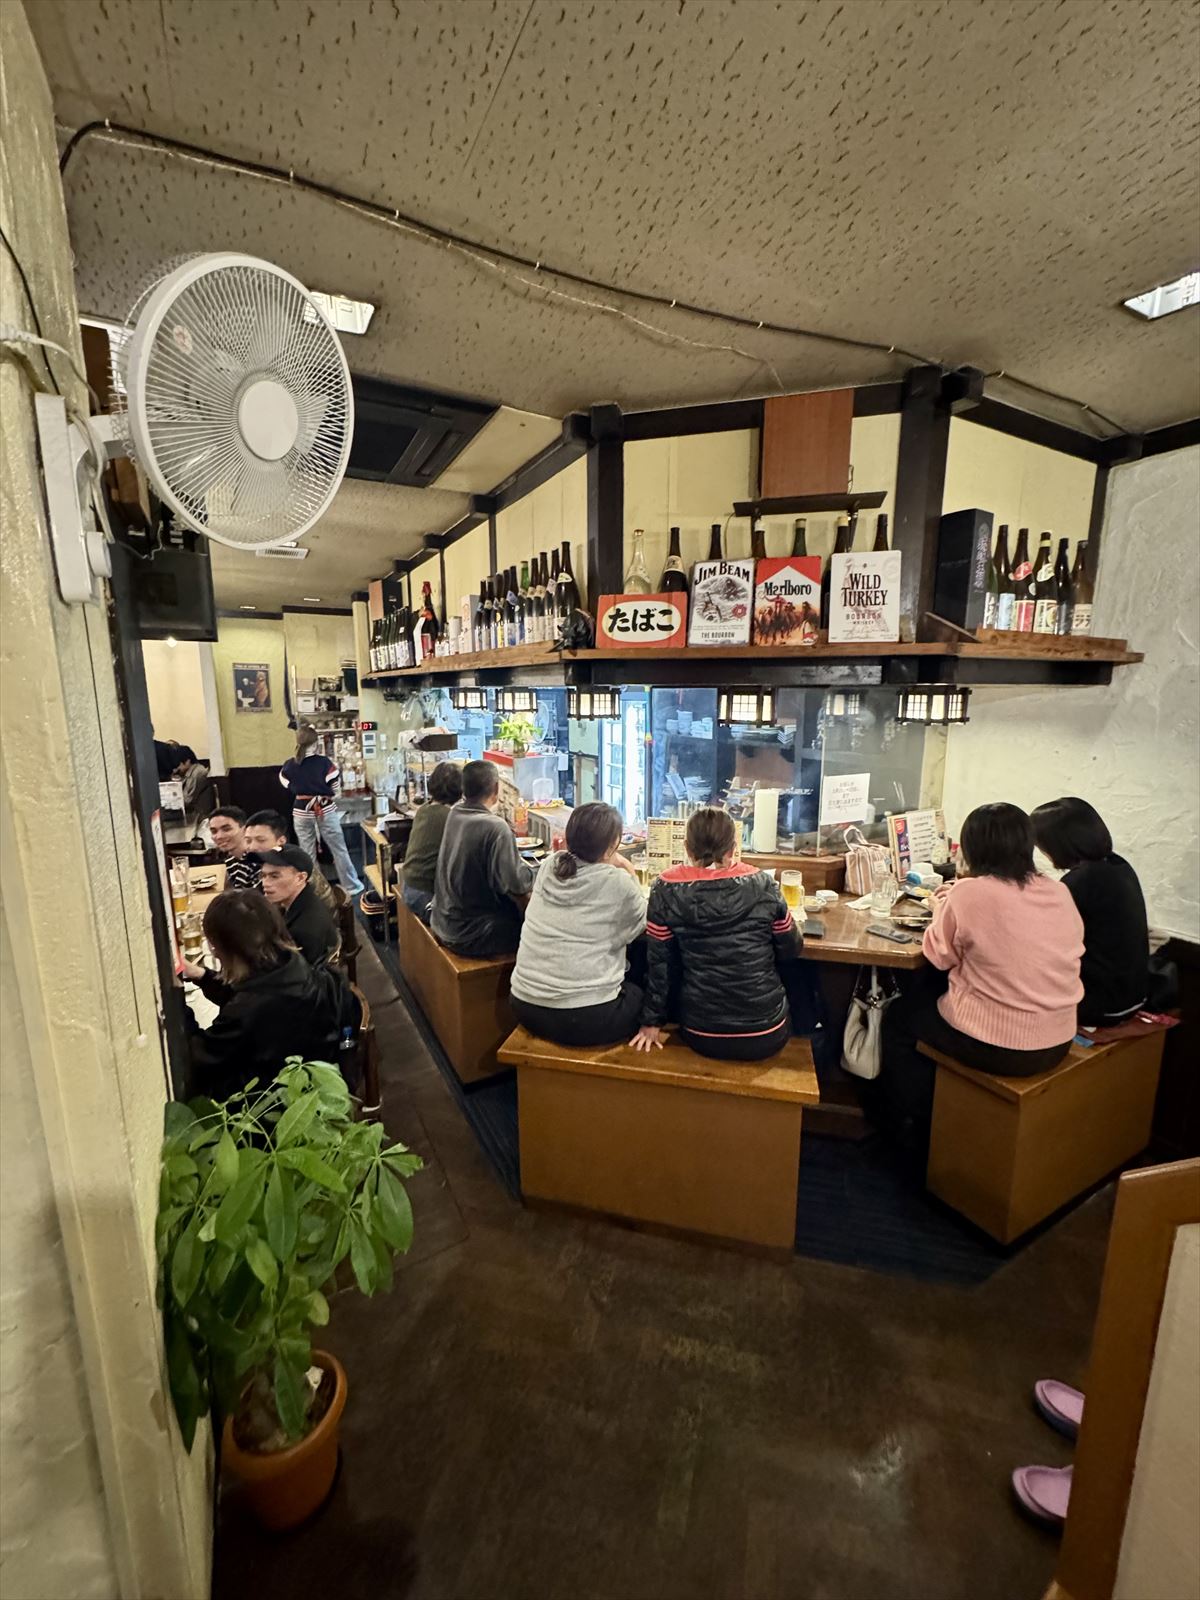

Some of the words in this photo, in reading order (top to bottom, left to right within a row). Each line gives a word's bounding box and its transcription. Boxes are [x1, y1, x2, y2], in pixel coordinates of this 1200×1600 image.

[694, 566, 717, 585] JIM
[719, 561, 750, 583] BEAM
[849, 573, 881, 590] WILD
[764, 580, 812, 596] Marlboro
[841, 587, 888, 607] TURKEY
[608, 608, 674, 633] たばこ
[711, 631, 735, 639] BOURBON
